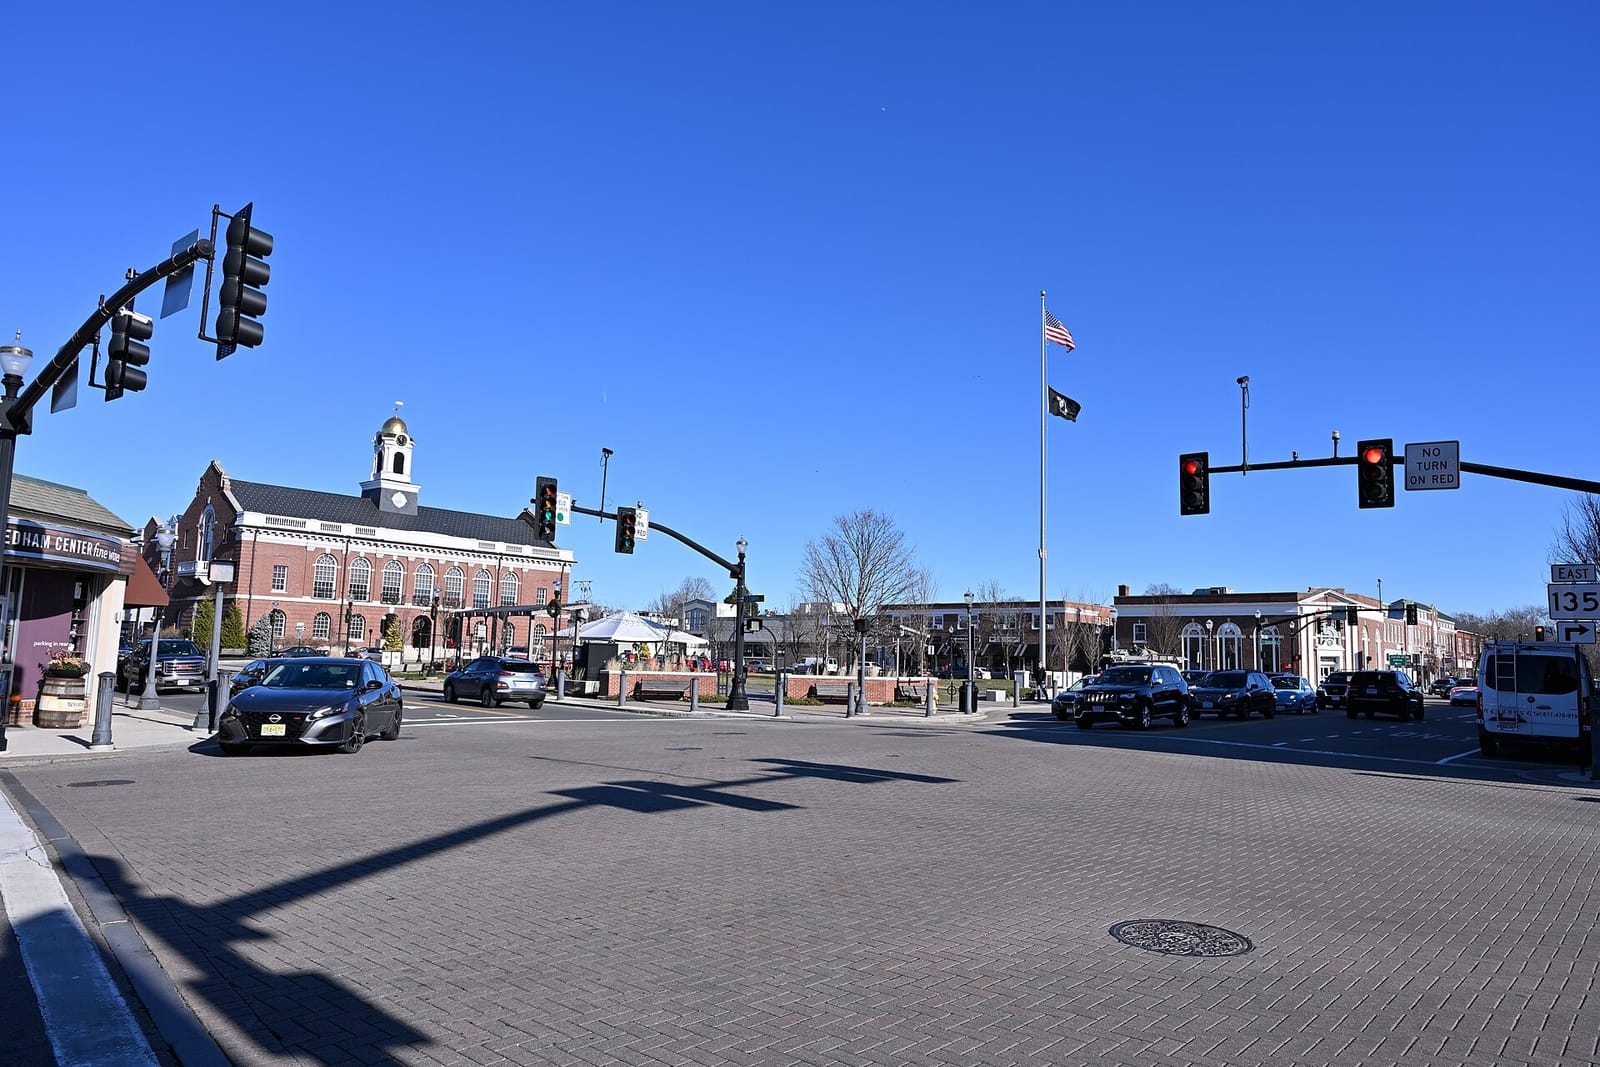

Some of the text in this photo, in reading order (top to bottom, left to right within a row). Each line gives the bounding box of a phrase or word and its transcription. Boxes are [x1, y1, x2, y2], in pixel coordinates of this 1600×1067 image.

[1422, 447, 1441, 458] NO
[1416, 460, 1448, 471] TURN
[1410, 474, 1455, 485] ON RED
[5, 529, 51, 549] EDHAM
[55, 536, 93, 556] CENTER
[93, 542, 108, 560] fine
[1558, 567, 1589, 579] EAST
[1552, 591, 1599, 612] 135
[33, 640, 53, 648] parking
